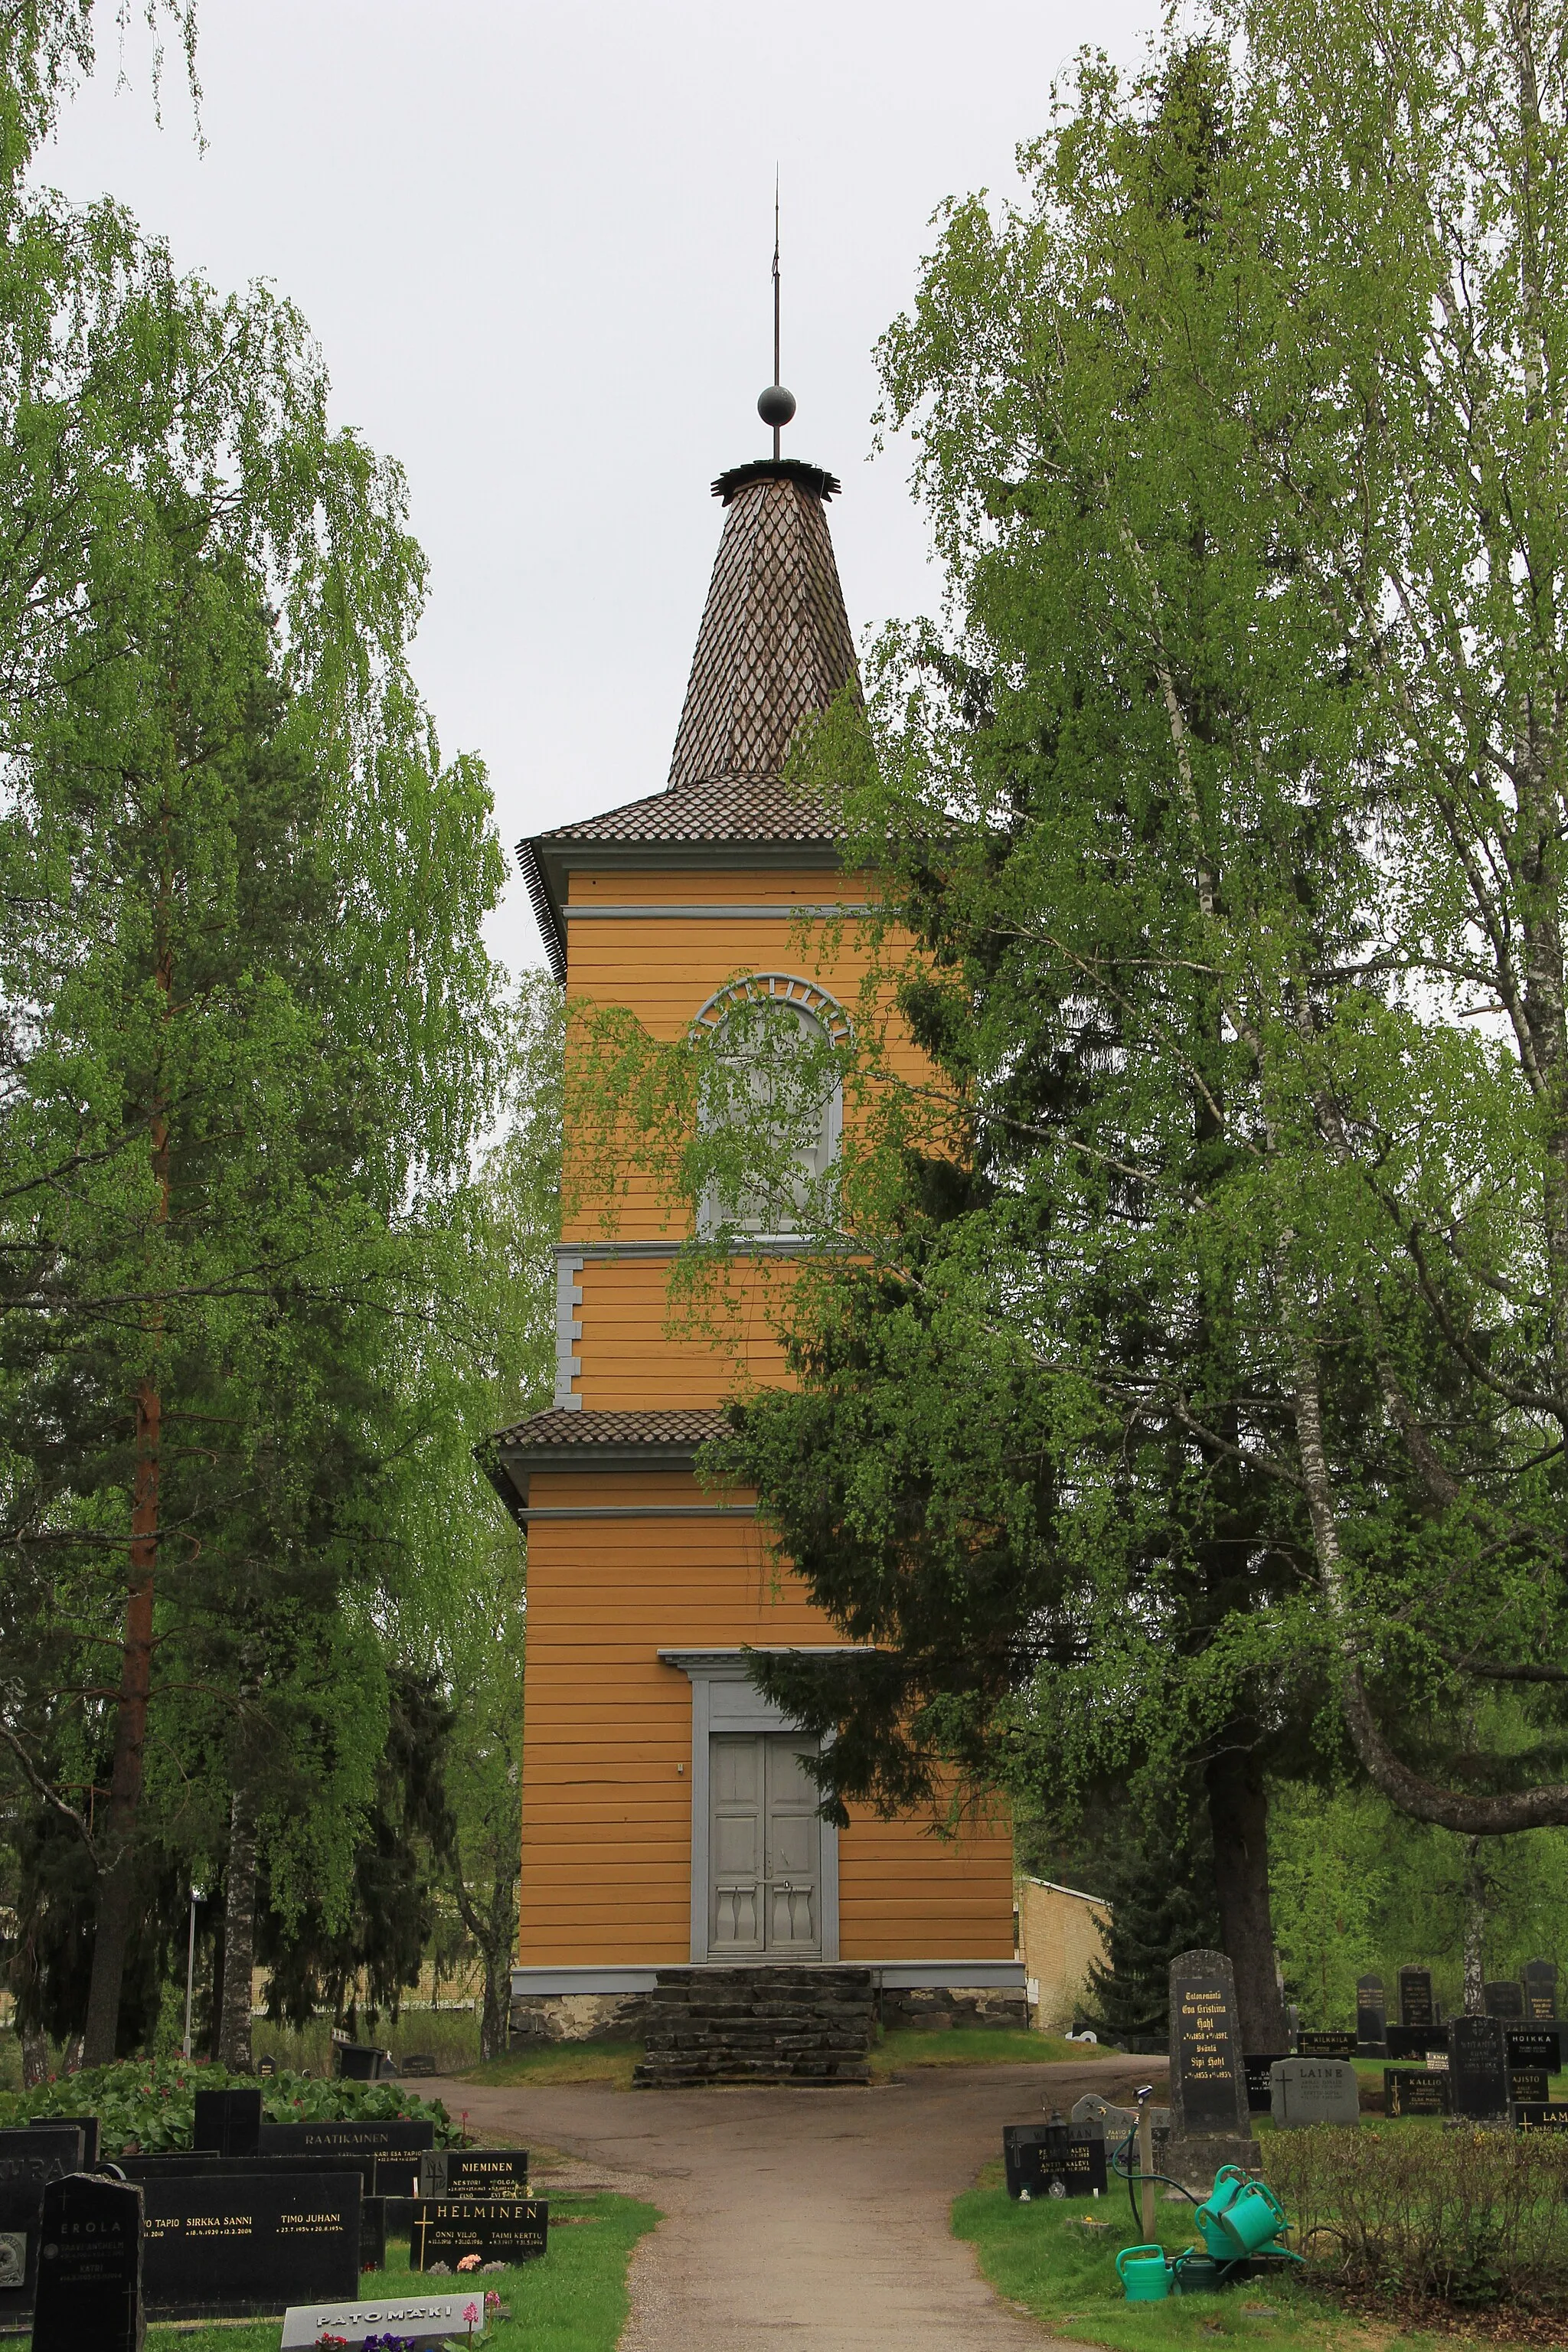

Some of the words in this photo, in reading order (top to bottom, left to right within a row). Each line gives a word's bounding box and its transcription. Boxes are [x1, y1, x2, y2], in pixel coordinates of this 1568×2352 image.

[1300, 2069, 1343, 2078] LAINE
[306, 2133, 389, 2145] RAATIKAINEN
[462, 2163, 512, 2171] NIEMINEN
[437, 2206, 537, 2218] HELMINEN
[155, 2219, 180, 2227] TAPIO
[186, 2217, 220, 2226] SIRKKA
[224, 2216, 252, 2225] SANNI
[280, 2214, 303, 2223] TIMO
[305, 2213, 340, 2223] JUHANI
[61, 2222, 121, 2234] EROLA
[316, 2305, 452, 2327] PATOMÄKI
